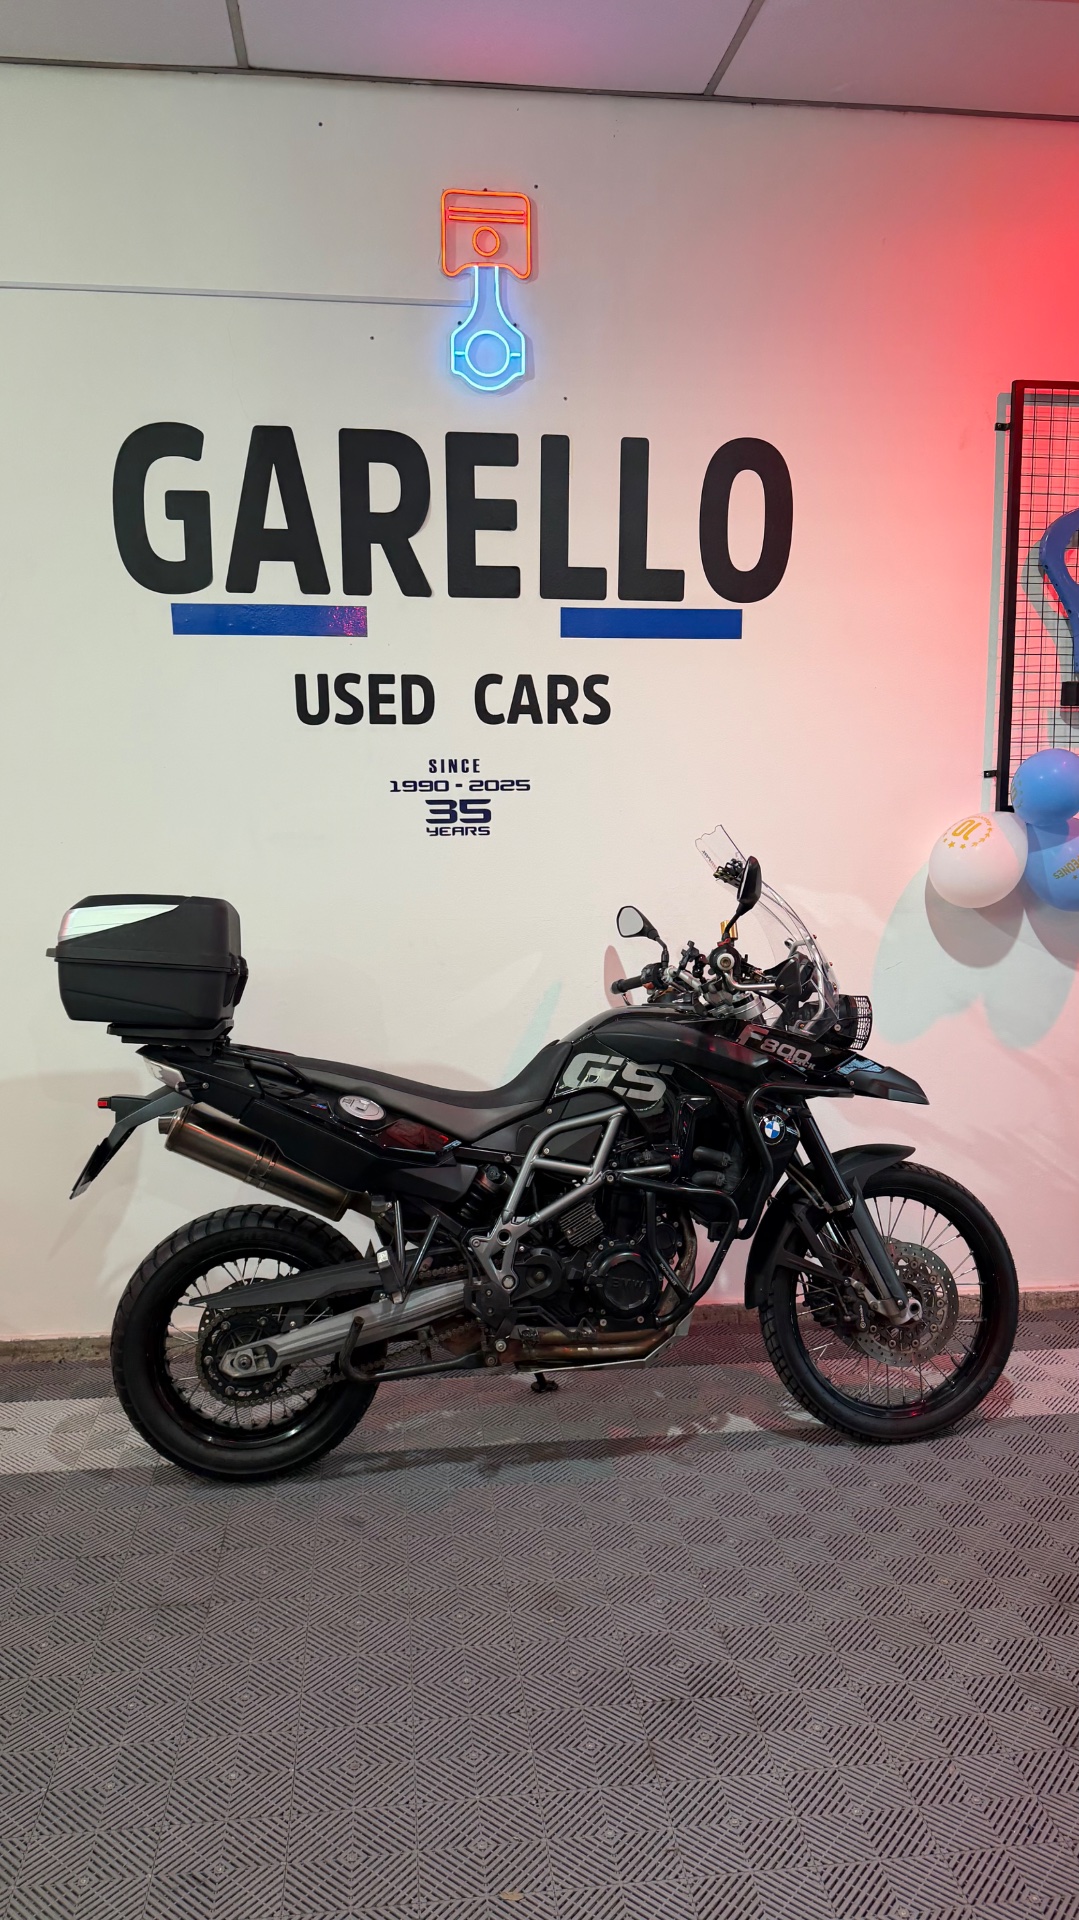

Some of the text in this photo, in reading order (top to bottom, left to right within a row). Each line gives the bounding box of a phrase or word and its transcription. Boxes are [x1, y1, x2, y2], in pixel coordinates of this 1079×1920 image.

[113, 422, 793, 603] GARELLO
[295, 673, 610, 725] USED CARS
[429, 759, 480, 773] SINCE
[390, 780, 449, 792] 1990
[469, 780, 530, 791] 2025
[425, 799, 491, 824] 35
[426, 826, 490, 836] YEARS
[562, 1052, 675, 1102] GS
